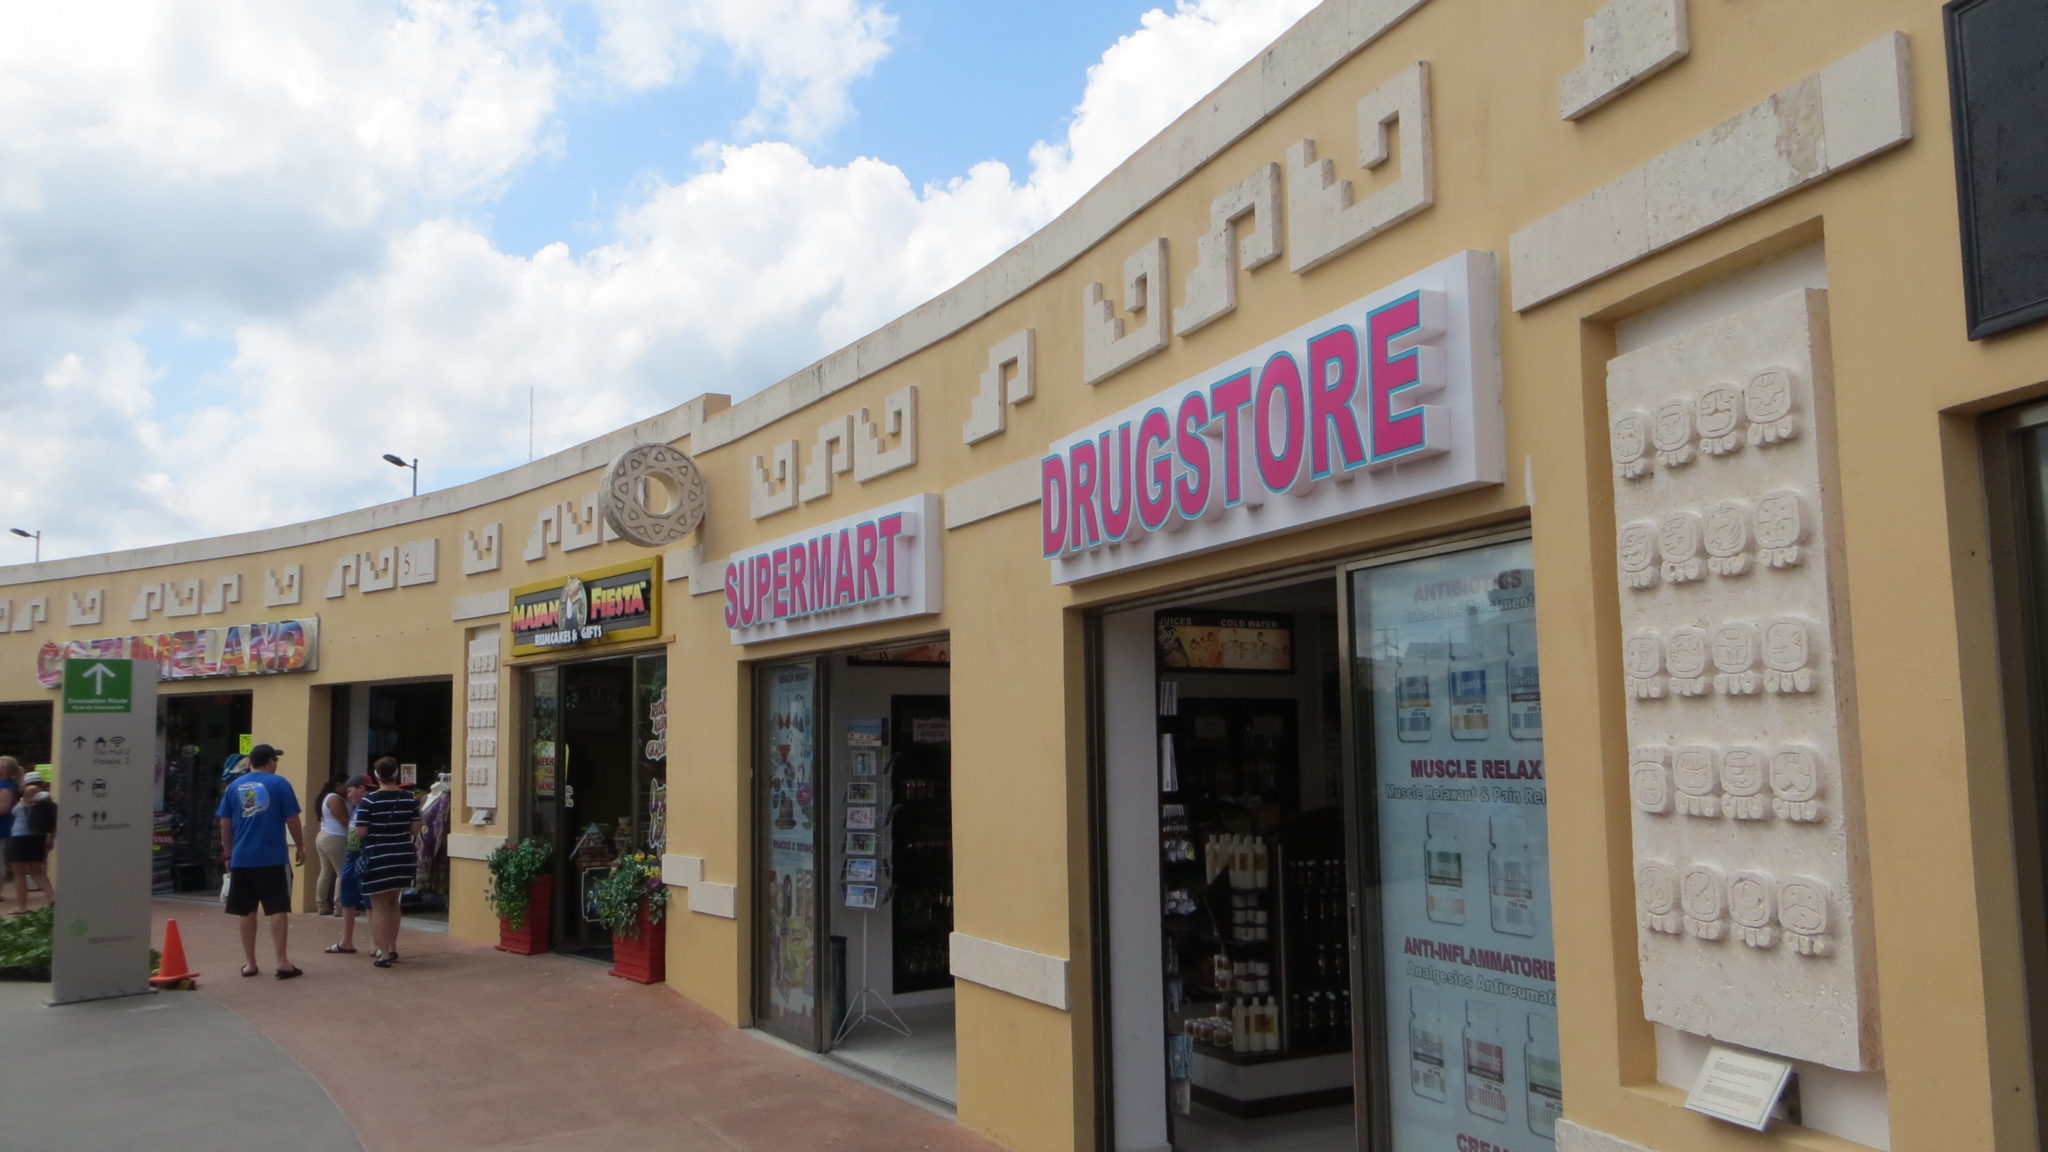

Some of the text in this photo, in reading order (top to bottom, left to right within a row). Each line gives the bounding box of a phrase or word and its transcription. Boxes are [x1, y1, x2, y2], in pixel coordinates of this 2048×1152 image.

[1042, 289, 1427, 560] DRUGSTORE
[724, 511, 902, 629] SUPERMART
[512, 583, 645, 632] MAYAN FIESTA
[581, 624, 602, 639] GIFTS
[1160, 617, 1278, 628] JUICES COLD WATER
[1410, 759, 1543, 780] MUSCLE RELAX
[1385, 784, 1424, 800] Muscle
[1425, 785, 1476, 802] Relaxant
[1481, 786, 1489, 803] &
[1493, 786, 1521, 804] Pain
[1406, 960, 1473, 988] Analgesics
